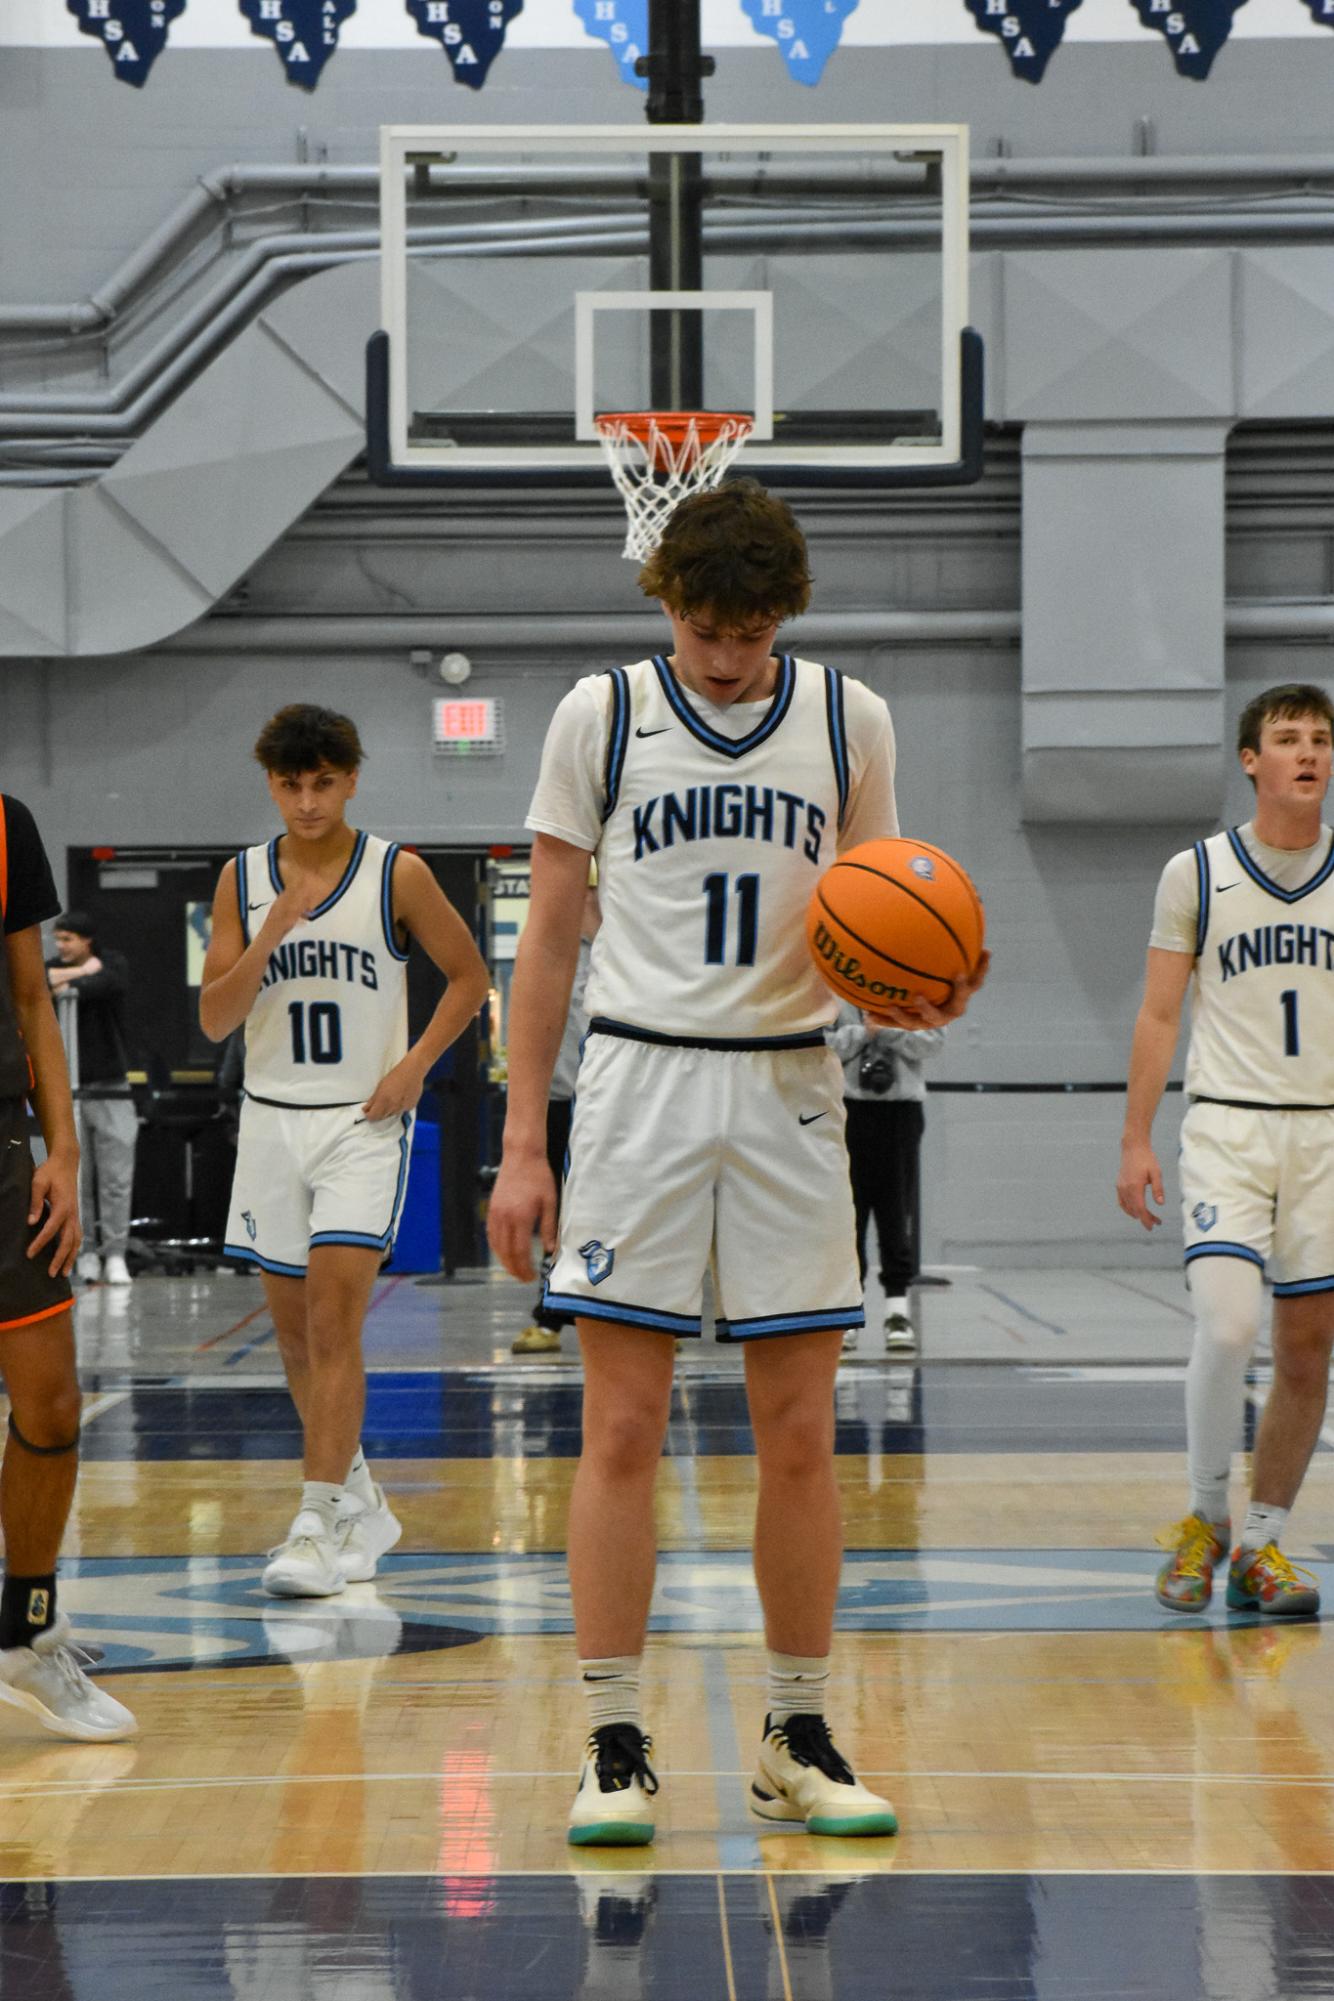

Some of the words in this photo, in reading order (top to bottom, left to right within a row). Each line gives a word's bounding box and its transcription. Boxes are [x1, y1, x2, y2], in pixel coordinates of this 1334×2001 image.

[633, 784, 826, 866] KNIGHTS
[702, 872, 760, 967] 11
[814, 920, 909, 1001] Wilson
[288, 1001, 343, 1064] 10
[1280, 989, 1300, 1057] 1
